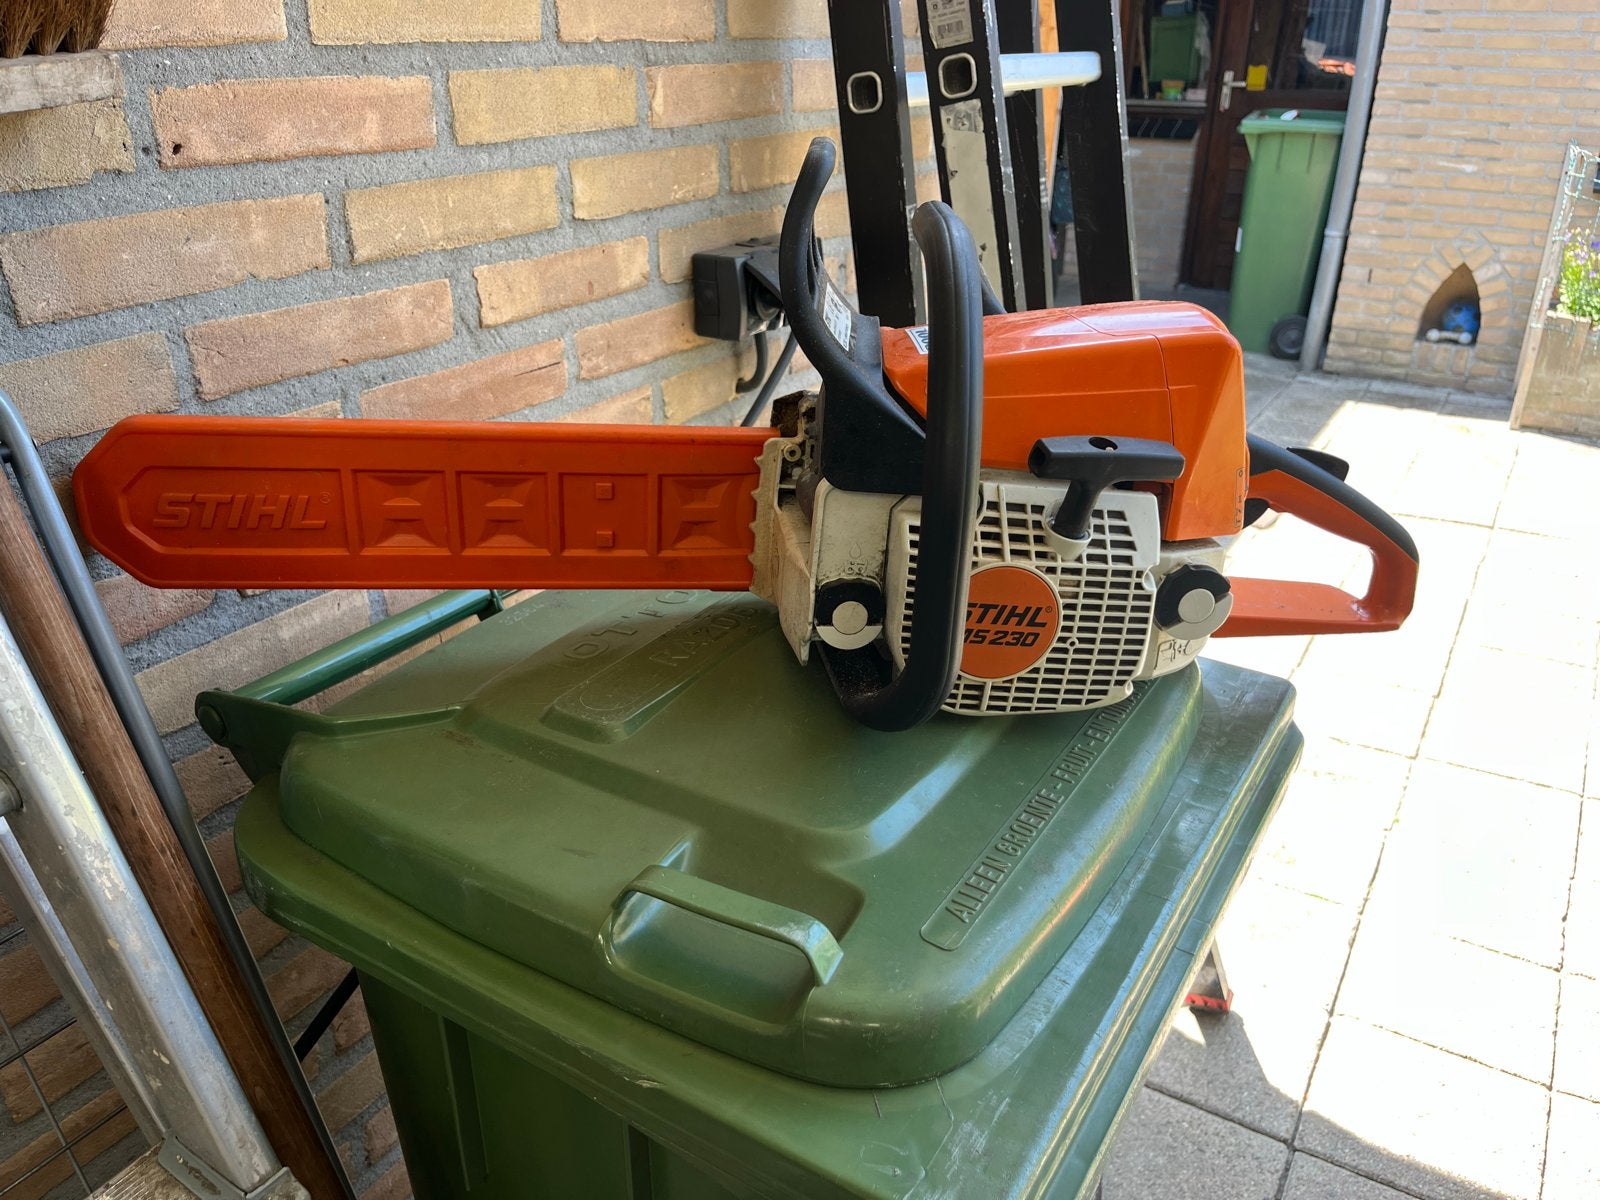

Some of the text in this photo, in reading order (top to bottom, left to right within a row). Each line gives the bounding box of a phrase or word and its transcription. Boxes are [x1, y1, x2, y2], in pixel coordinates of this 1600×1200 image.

[152, 492, 327, 530] STIHL
[988, 630, 1040, 647] 230
[945, 855, 1012, 924] ALLEEN
[994, 788, 1065, 857] GROENTE
[1050, 744, 1098, 785] FRUIT
[1083, 721, 1115, 743] EN
